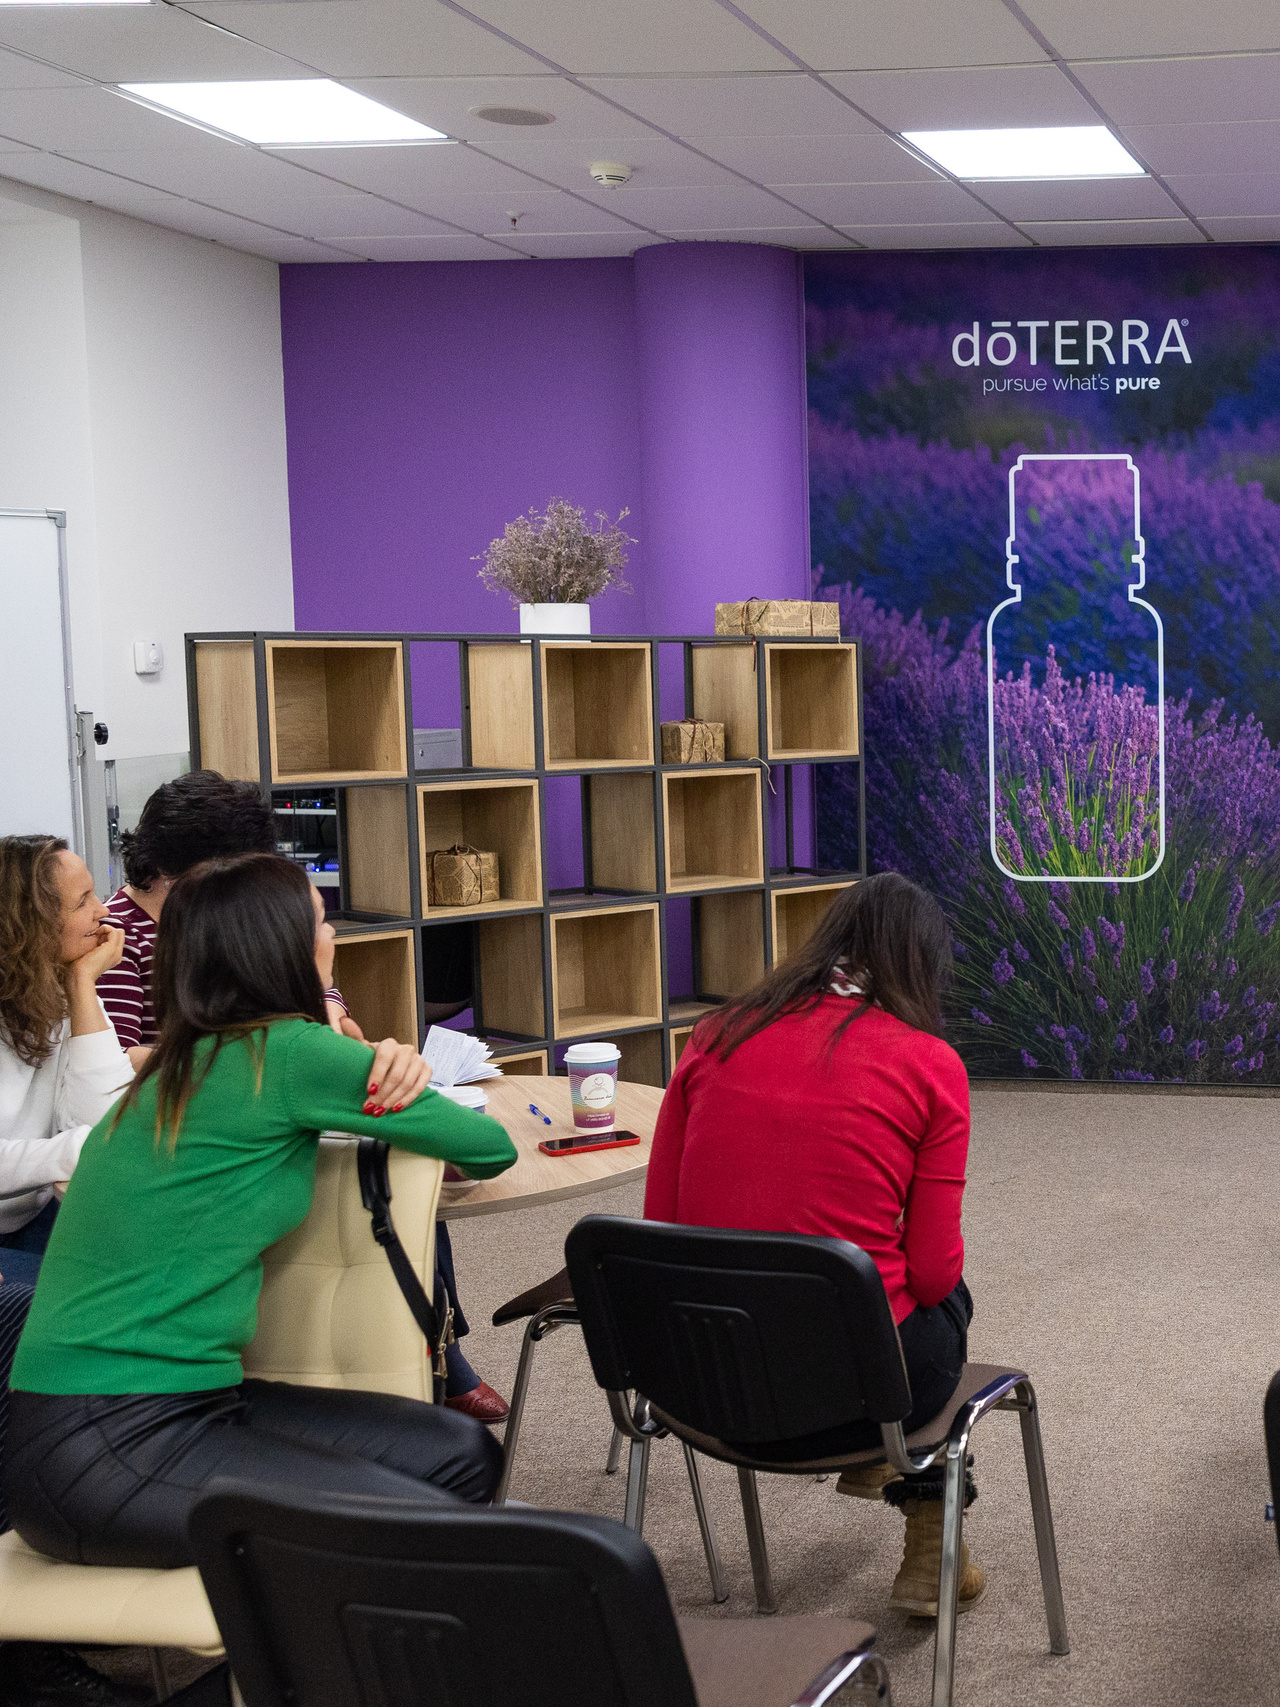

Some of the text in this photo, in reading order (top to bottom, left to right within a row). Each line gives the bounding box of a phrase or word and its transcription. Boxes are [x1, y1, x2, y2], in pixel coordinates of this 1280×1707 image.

[983, 374, 1161, 395] pursue what's pure
